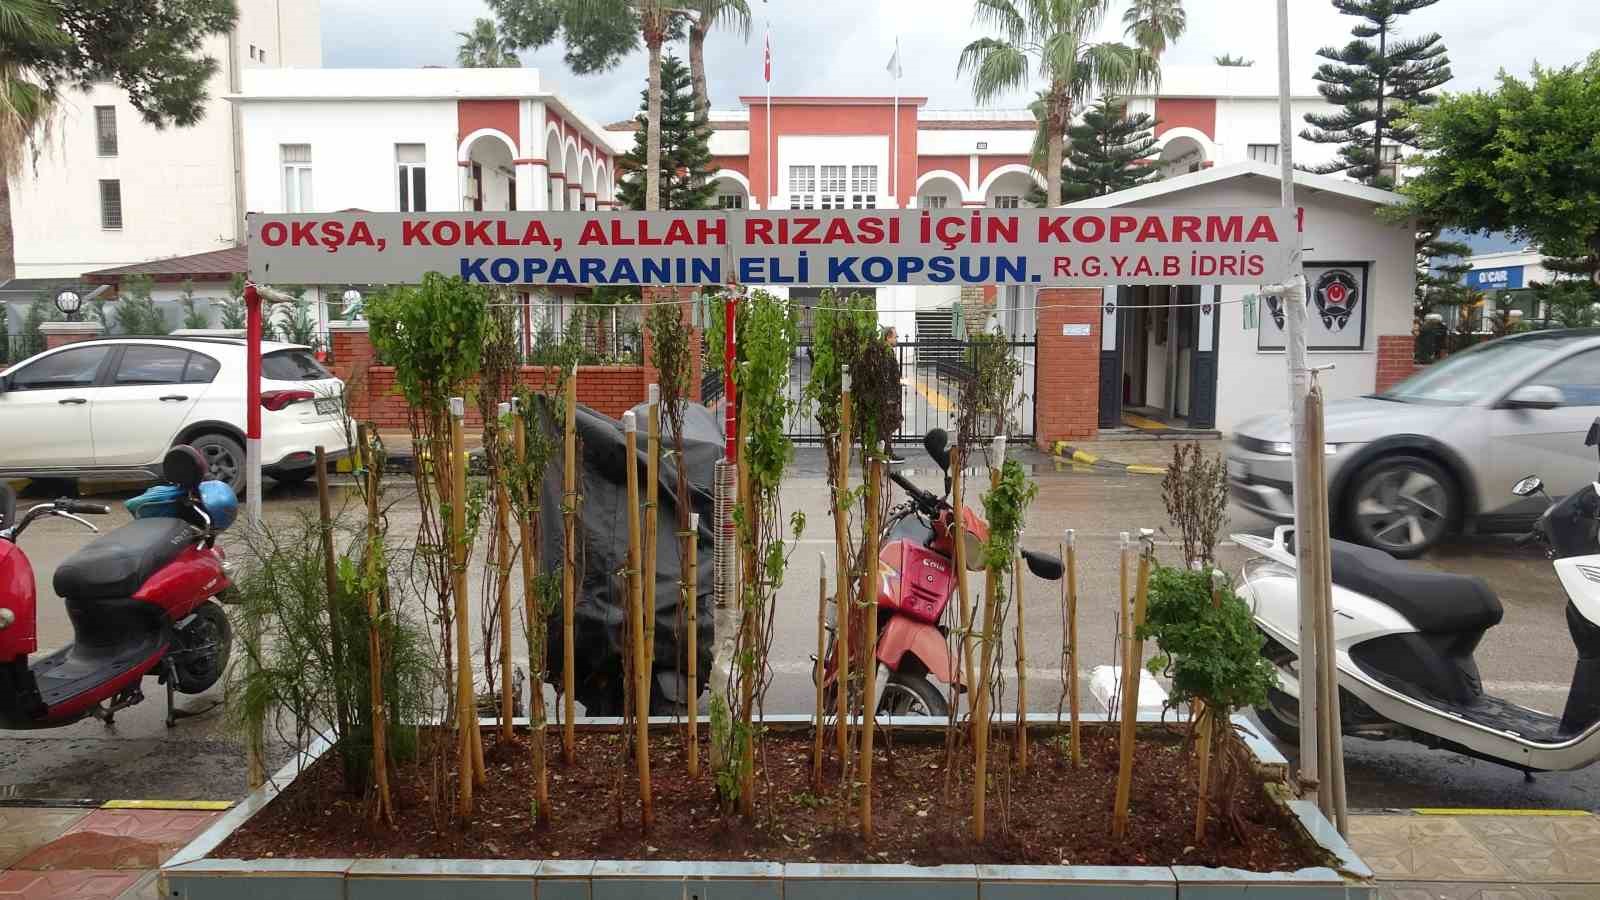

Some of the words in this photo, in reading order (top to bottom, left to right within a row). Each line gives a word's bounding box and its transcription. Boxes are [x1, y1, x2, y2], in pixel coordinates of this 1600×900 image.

[261, 219, 387, 253] OKŞA,
[403, 218, 563, 252] KOKLA,
[578, 218, 727, 246] ALLAH
[743, 216, 901, 246] RIZASI
[919, 211, 1020, 250] İÇİN
[1037, 214, 1279, 246] KOPARMA
[460, 256, 721, 284] KOPARANIN
[738, 251, 809, 284] ELİ
[828, 255, 1041, 284] KOPSUN.
[1054, 255, 1180, 278] R.G.Y.A.B
[1190, 249, 1265, 277] İDRİS
